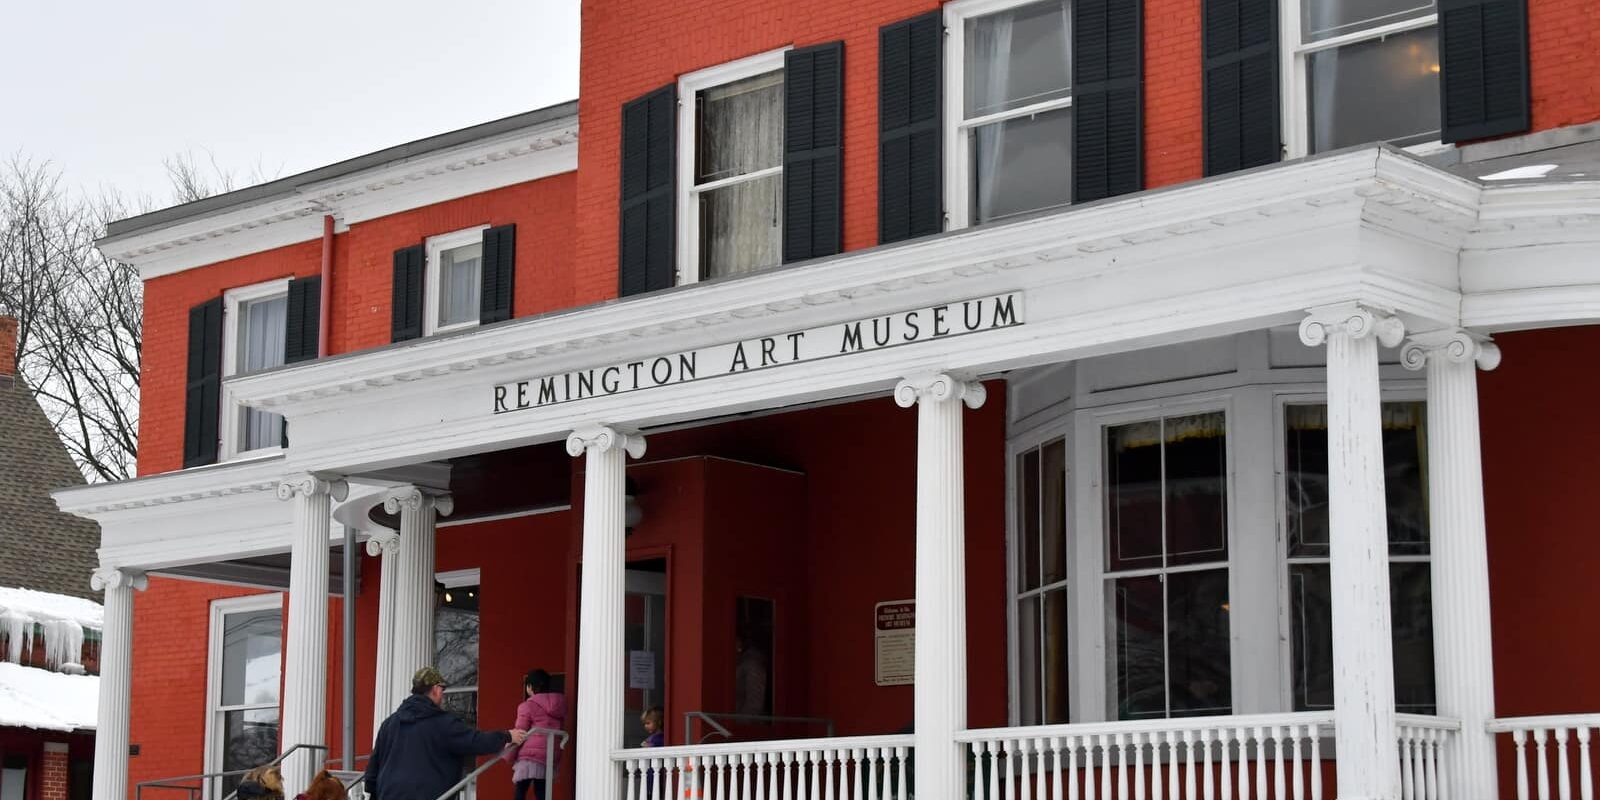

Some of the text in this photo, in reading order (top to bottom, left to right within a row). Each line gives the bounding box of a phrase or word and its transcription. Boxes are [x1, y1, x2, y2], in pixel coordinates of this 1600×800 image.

[493, 294, 1017, 412] REMINGTON ART MUSEUM
